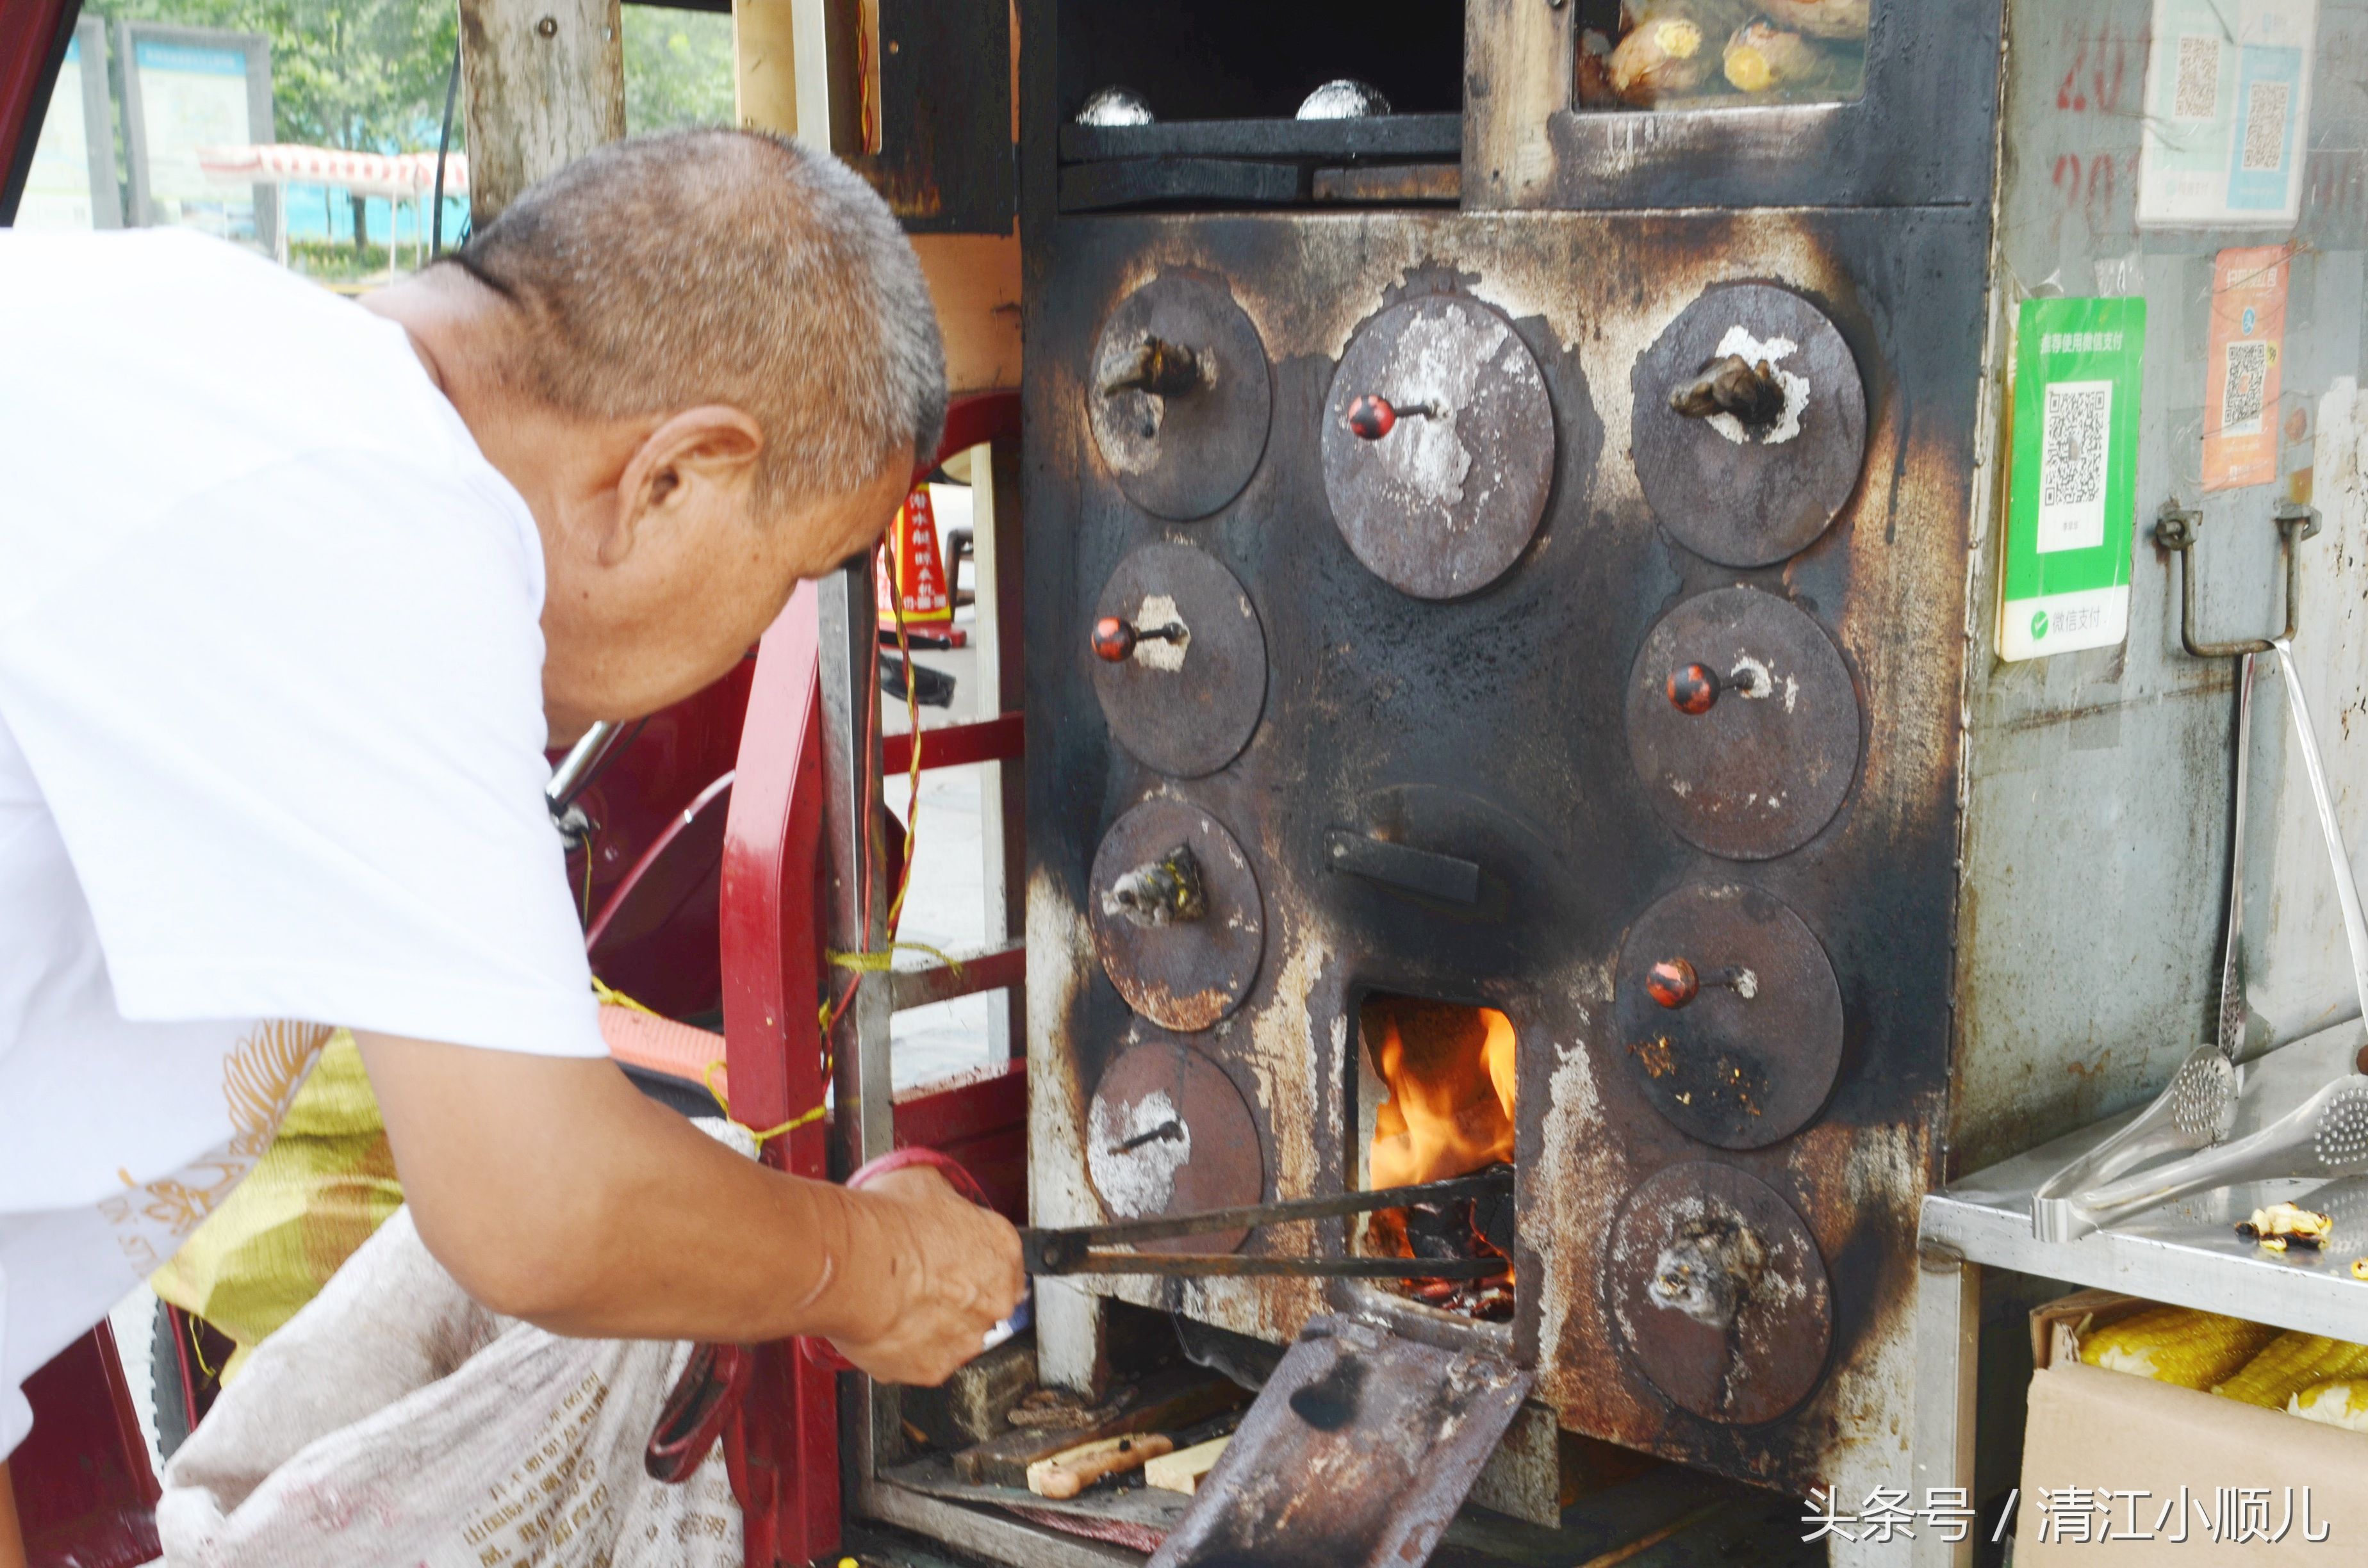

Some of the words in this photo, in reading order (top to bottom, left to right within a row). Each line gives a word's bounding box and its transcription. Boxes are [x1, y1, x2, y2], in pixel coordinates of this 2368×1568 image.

[2041, 331, 2123, 354] 推荐使用微信支付
[2053, 606, 2100, 633] 微信支付
